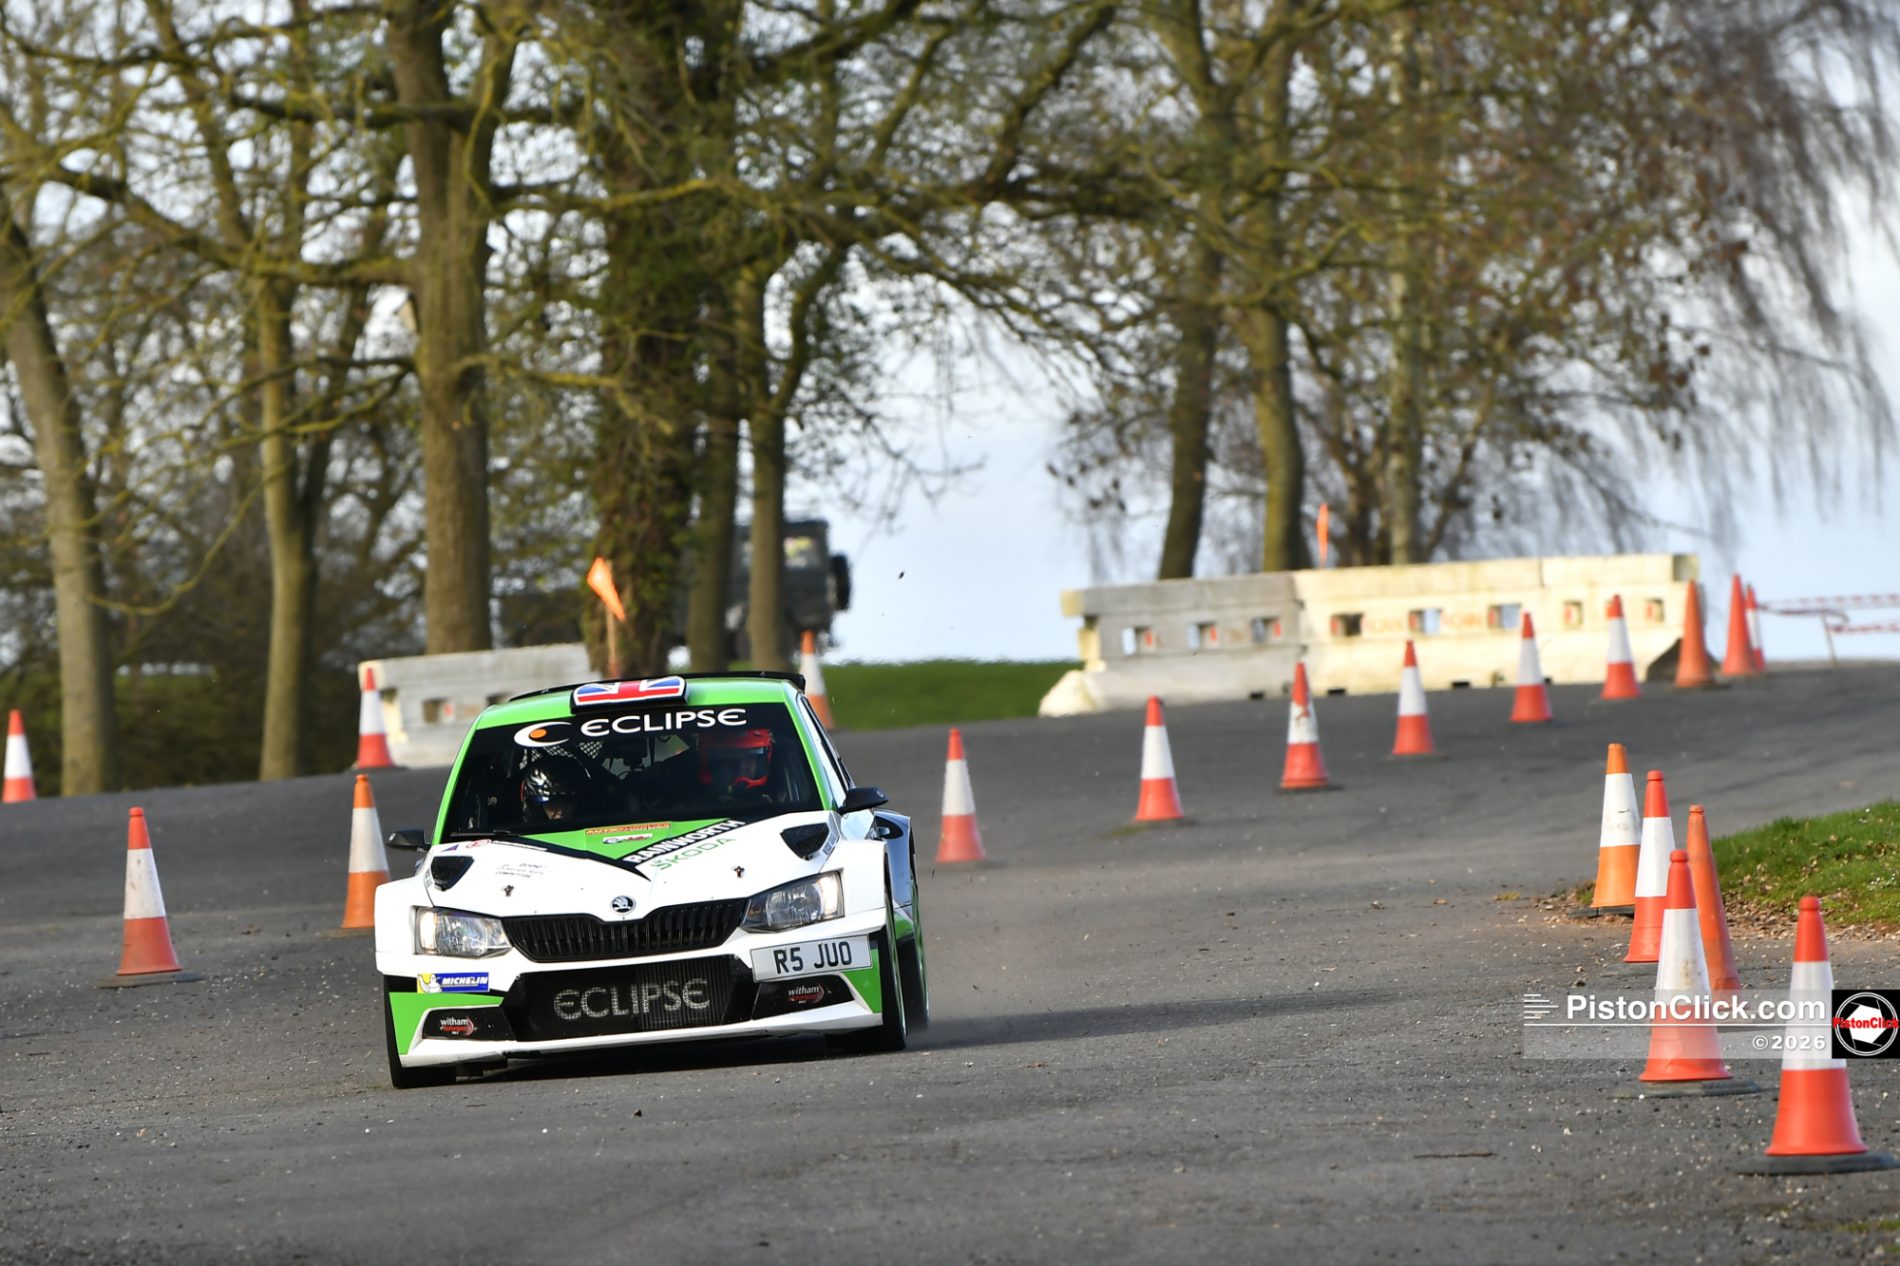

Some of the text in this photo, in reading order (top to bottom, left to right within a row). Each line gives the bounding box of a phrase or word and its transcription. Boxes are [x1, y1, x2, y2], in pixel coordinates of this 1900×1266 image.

[580, 708, 747, 737] ECLIPSE
[622, 819, 747, 864] RAINWORTH
[773, 946, 804, 975] R5
[441, 976, 489, 985] MICHELIN
[788, 984, 820, 996] witham
[553, 978, 711, 1020] ECLIPSE
[440, 1016, 468, 1026] witham
